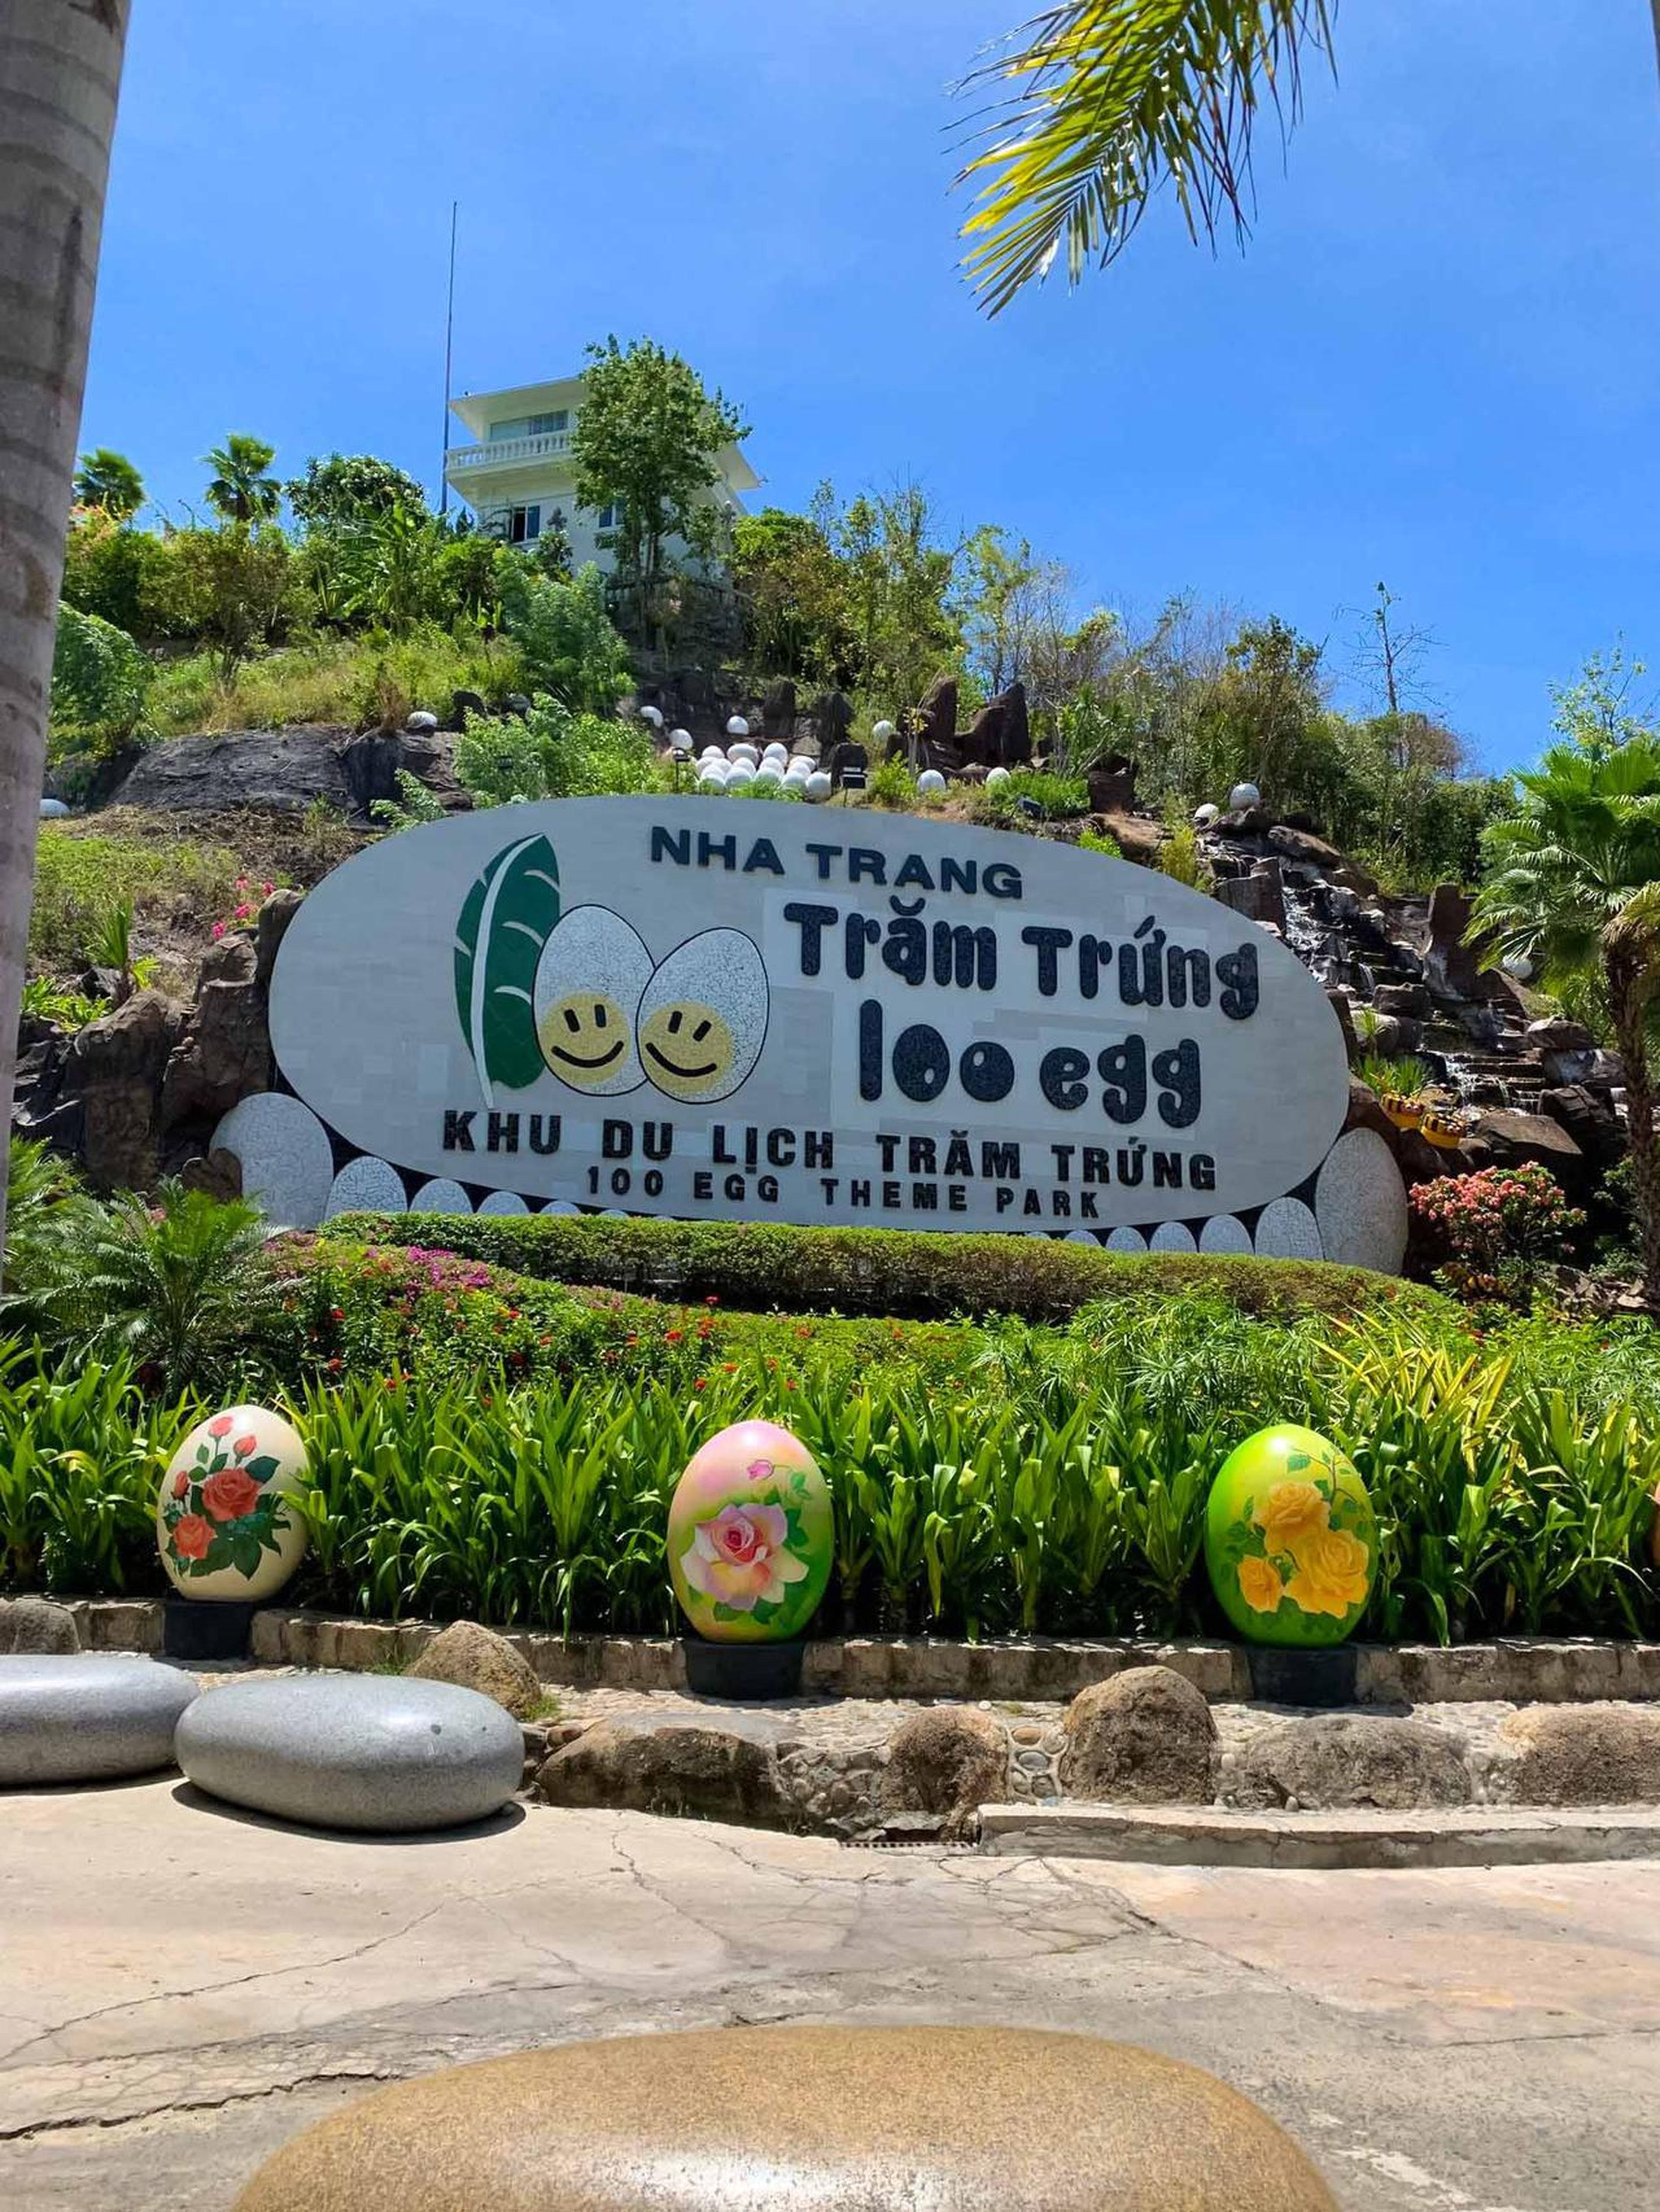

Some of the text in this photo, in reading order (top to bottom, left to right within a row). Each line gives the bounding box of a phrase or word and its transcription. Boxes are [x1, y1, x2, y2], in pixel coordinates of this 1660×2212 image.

[651, 826, 1022, 899] NHA TRANG
[783, 895, 1259, 1020] Trăm Trứng
[1039, 1034, 1201, 1128] egg
[442, 1110, 1216, 1191] KHU DU LỊCH TRĂM TRỨNG
[587, 1166, 1099, 1218] 100 EGG THEME PARK
